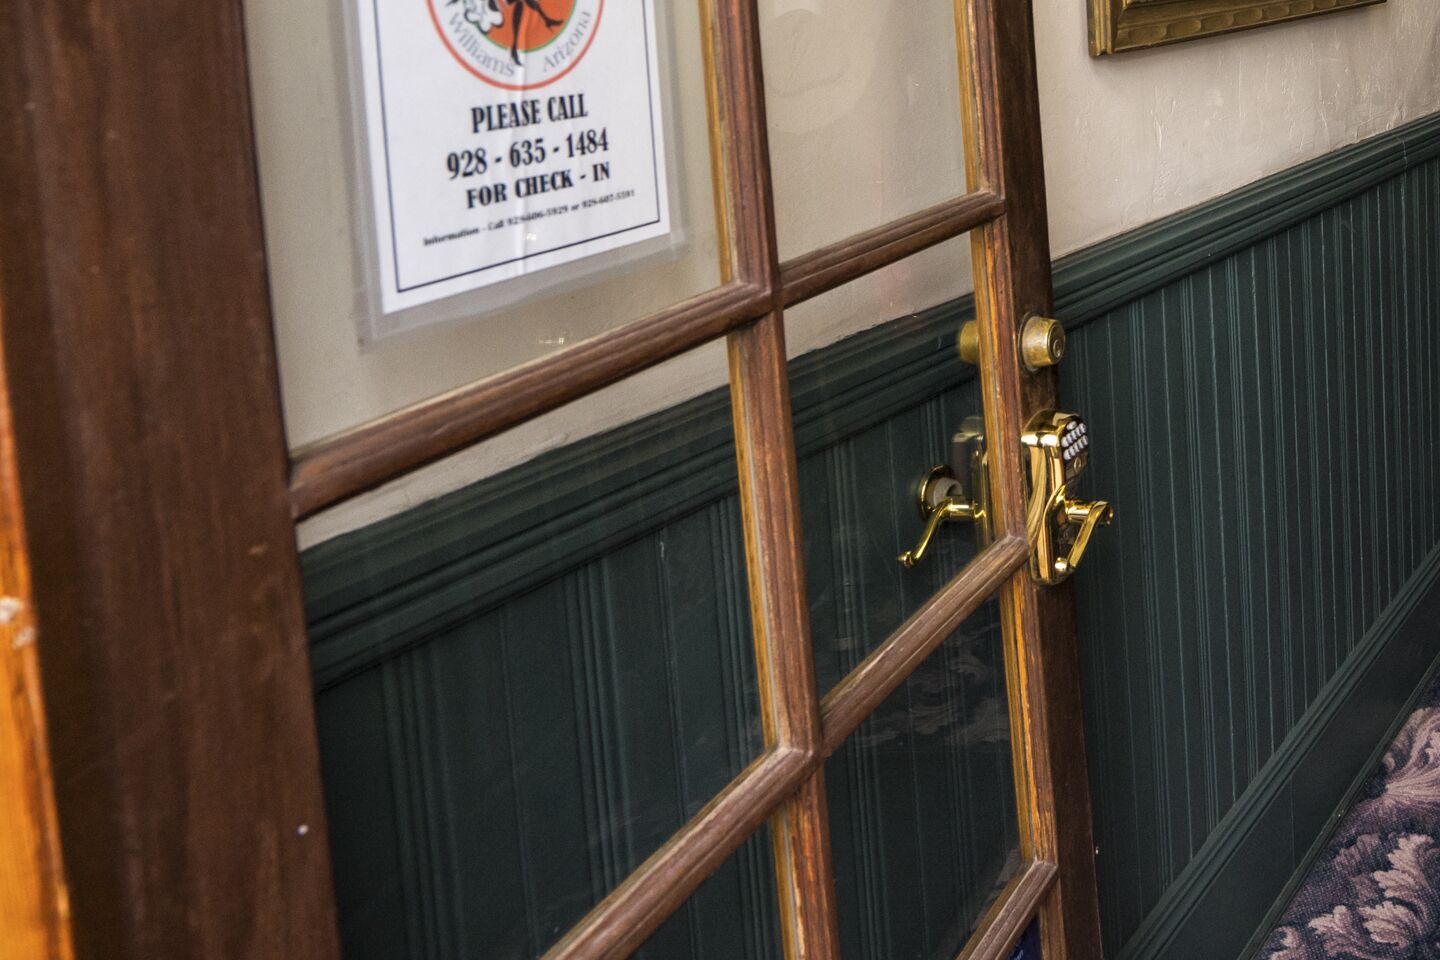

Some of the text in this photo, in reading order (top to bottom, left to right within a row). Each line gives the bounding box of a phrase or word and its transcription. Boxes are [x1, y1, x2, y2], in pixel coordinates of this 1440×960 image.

[449, 11, 591, 77] Williams Arizona
[471, 93, 589, 134] PLEASE CALL
[447, 147, 488, 180] 928
[510, 138, 546, 168] 635
[565, 127, 609, 158] 1484
[466, 183, 507, 209] FOR
[515, 169, 573, 198] CHECK
[592, 161, 611, 182] IN
